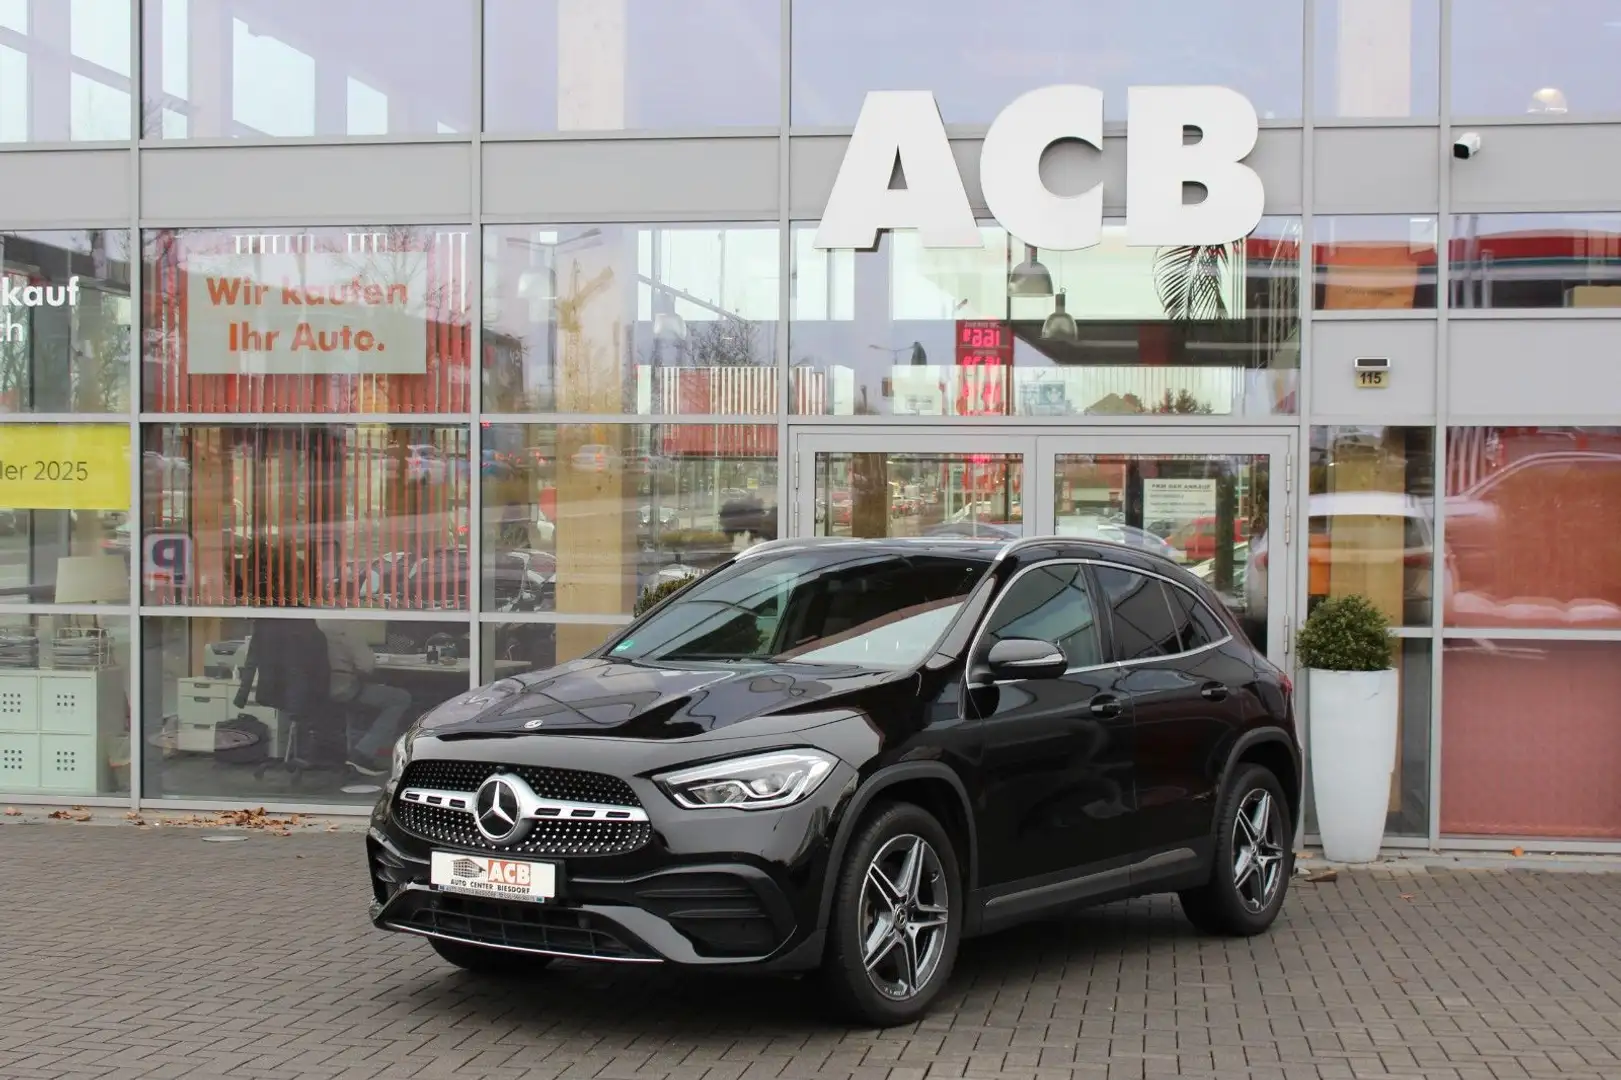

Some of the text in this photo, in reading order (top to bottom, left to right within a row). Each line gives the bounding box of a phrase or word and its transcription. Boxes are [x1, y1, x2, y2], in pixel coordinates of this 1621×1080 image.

[813, 84, 1264, 251] ACB
[1, 276, 80, 307] kauf
[206, 275, 409, 305] Wir kaufen
[229, 321, 386, 352] Ihr Auto.
[1360, 371, 1382, 385] 115
[34, 460, 88, 481] 2025
[450, 878, 467, 887] AUTO
[470, 881, 494, 890] CENTER
[497, 884, 531, 894] BIESDORF
[488, 861, 531, 885] ACB
